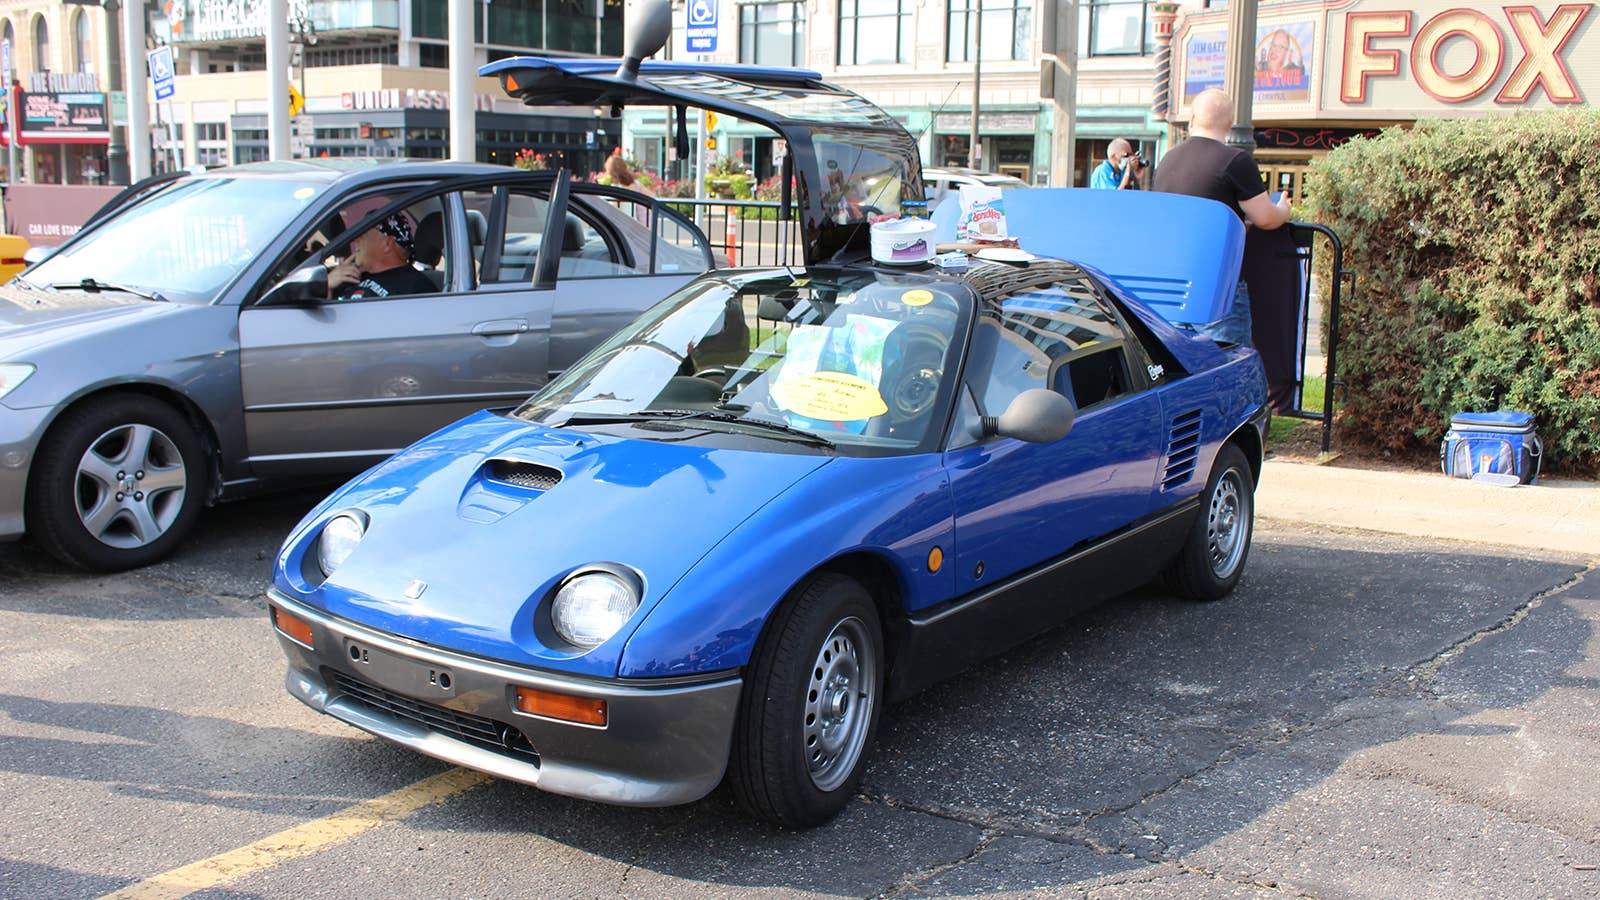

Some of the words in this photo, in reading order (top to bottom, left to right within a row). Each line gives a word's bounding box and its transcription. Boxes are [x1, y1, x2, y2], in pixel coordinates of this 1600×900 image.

[194, 0, 238, 29] Little
[1341, 4, 1592, 103] FOX
[28, 72, 47, 92] THE
[48, 72, 99, 92] FILLMORE
[352, 88, 399, 109] UNION
[406, 88, 497, 112] ASSLY
[1263, 128, 1376, 149] Detrt
[29, 223, 42, 234] CAR
[43, 223, 60, 235] LOVE
